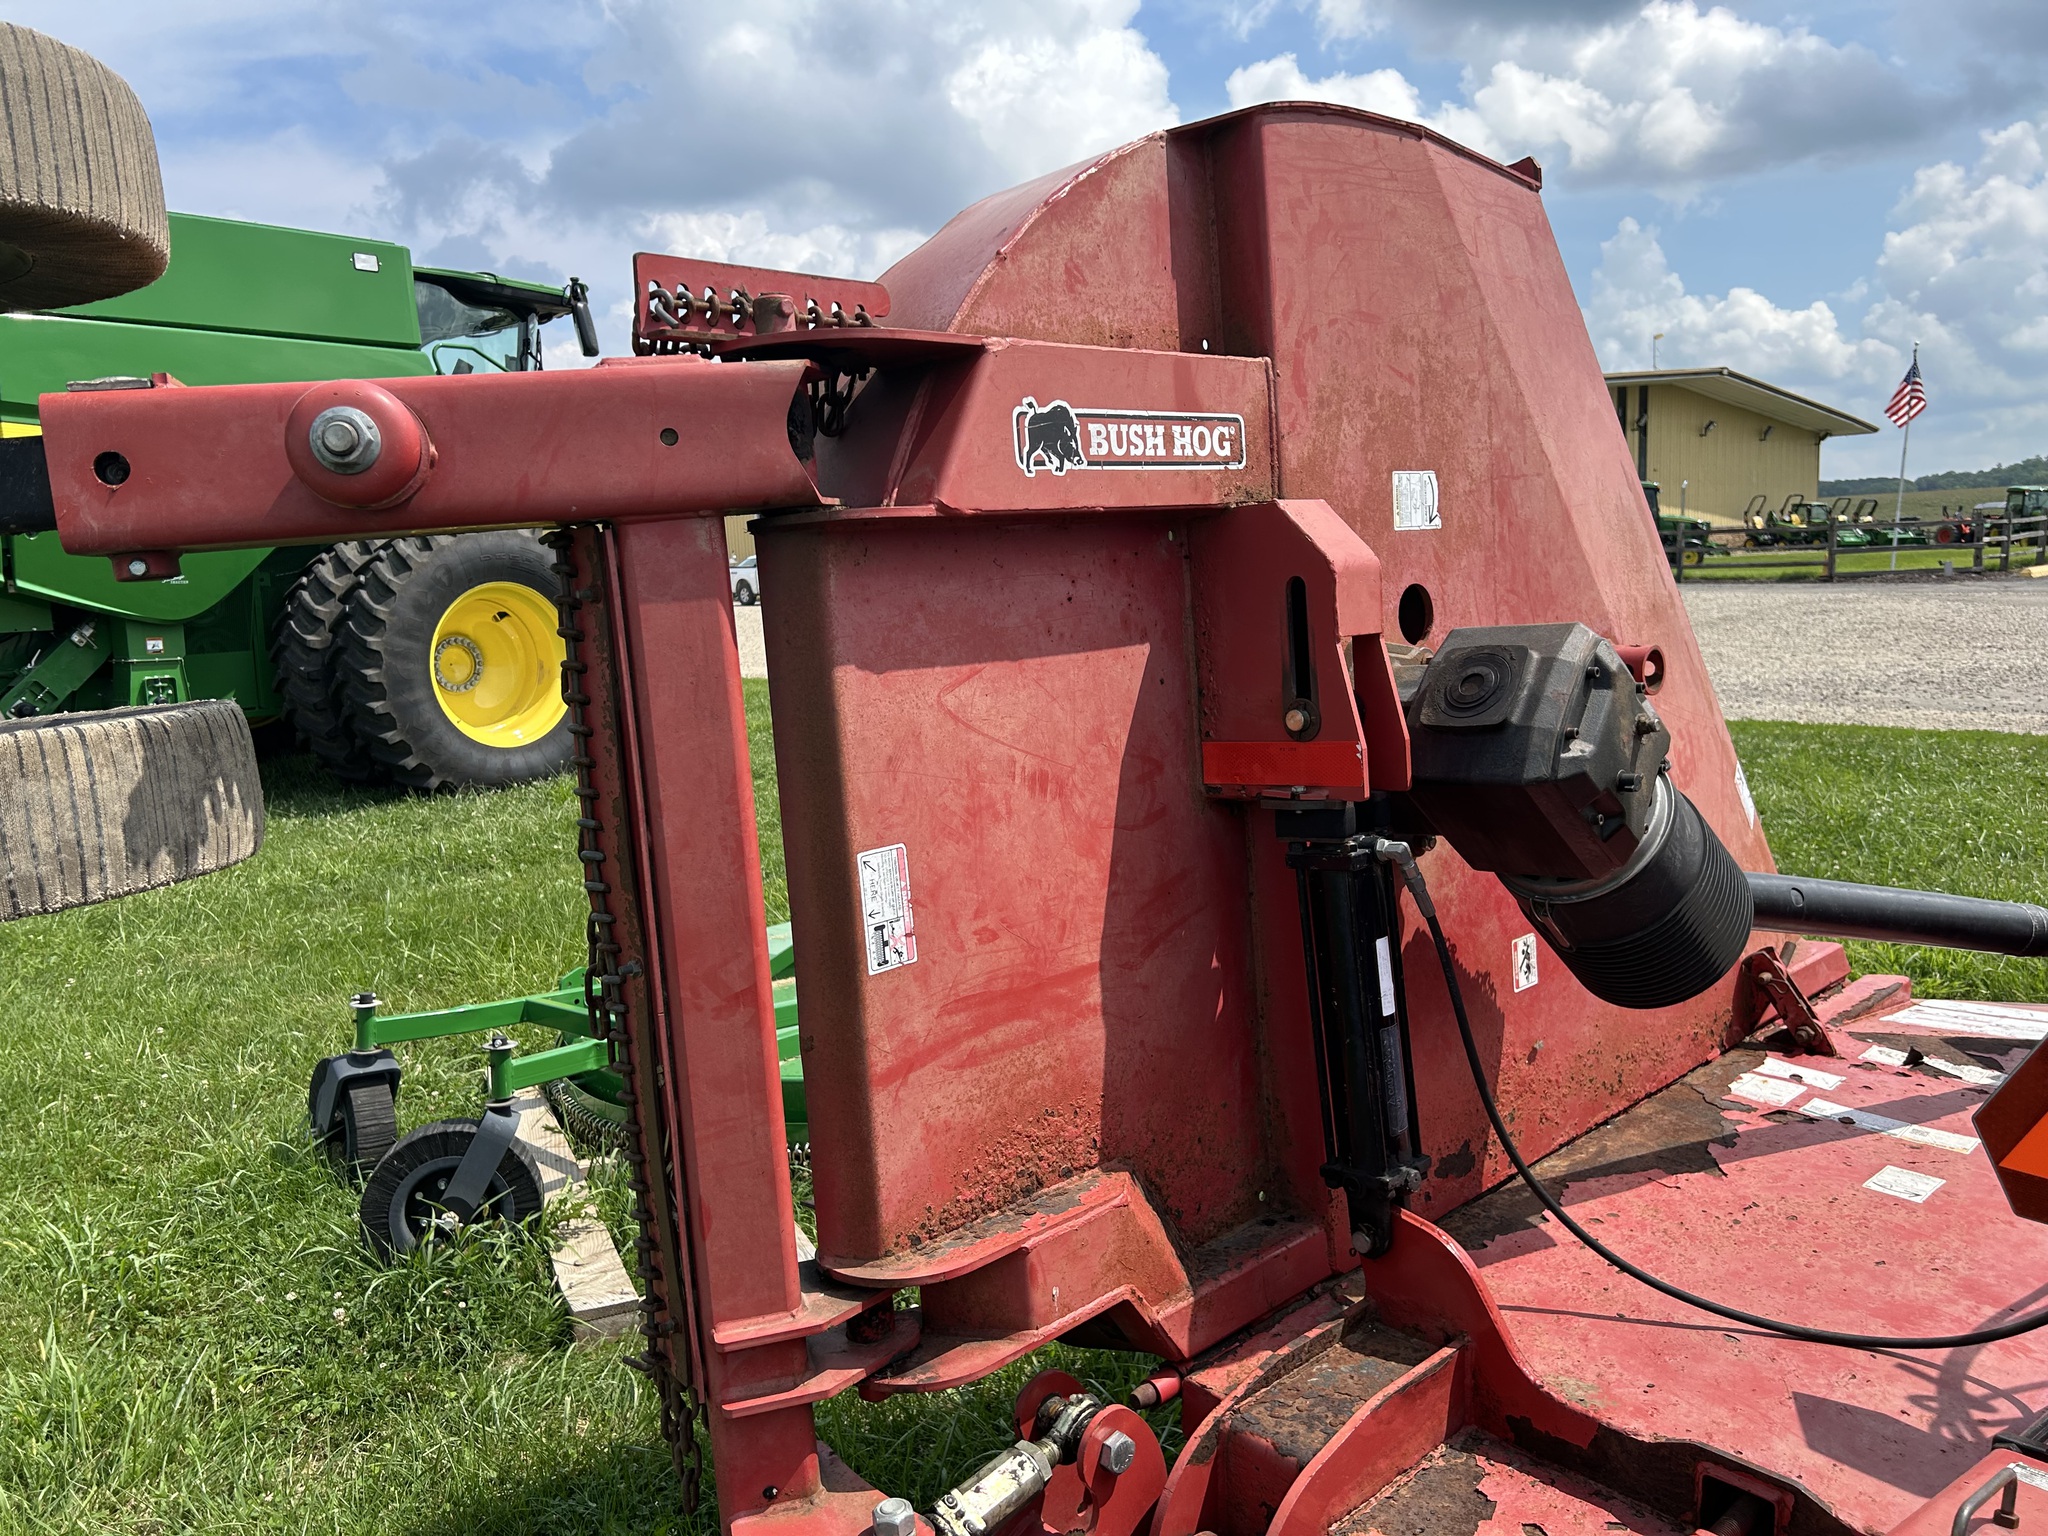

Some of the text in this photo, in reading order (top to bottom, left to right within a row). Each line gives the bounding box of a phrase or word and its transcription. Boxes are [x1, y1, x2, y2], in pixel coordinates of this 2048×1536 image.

[1087, 423, 1232, 457] BUSH HOG
[869, 878, 878, 903] HERE
[902, 890, 910, 923] DANGER
